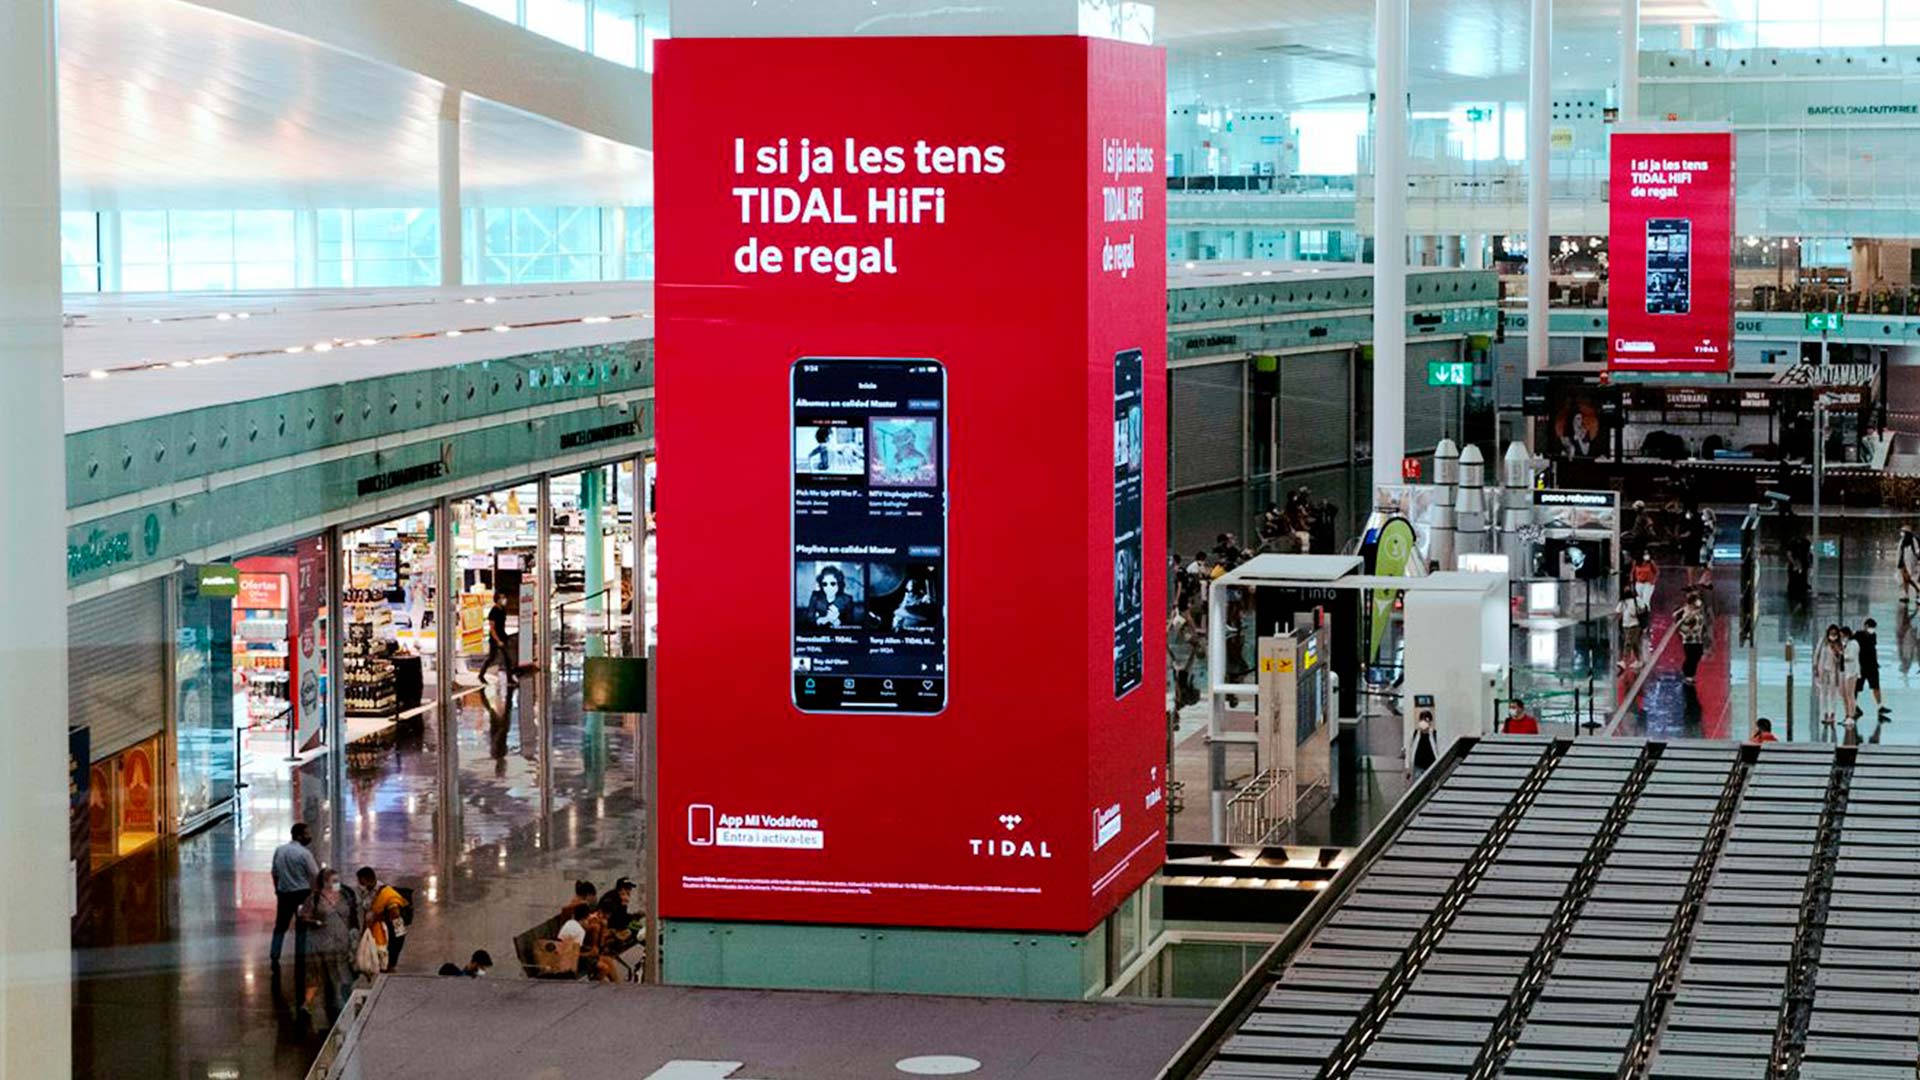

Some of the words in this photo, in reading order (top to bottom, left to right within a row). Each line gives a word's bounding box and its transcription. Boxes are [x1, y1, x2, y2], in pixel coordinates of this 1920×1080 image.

[735, 138, 745, 174] I
[756, 137, 789, 174] si
[798, 137, 834, 183] ja
[845, 138, 906, 174] les
[914, 140, 1006, 174] tens
[1662, 159, 1680, 171] les
[1681, 160, 1709, 171] tens
[1631, 172, 1667, 184] TIDAL
[1631, 186, 1646, 197] de
[1647, 186, 1679, 200] regal
[732, 187, 858, 224] TIDAL
[868, 187, 945, 224] HiFi
[1103, 187, 1127, 222] TIDAL
[734, 237, 783, 273] de
[794, 237, 897, 283] regal
[1309, 587, 1337, 600] info
[719, 803, 744, 829] App
[761, 805, 819, 829] Vodafone
[722, 831, 754, 844] Entra
[762, 832, 818, 846] activa-les
[969, 839, 1052, 858] TIDAL
